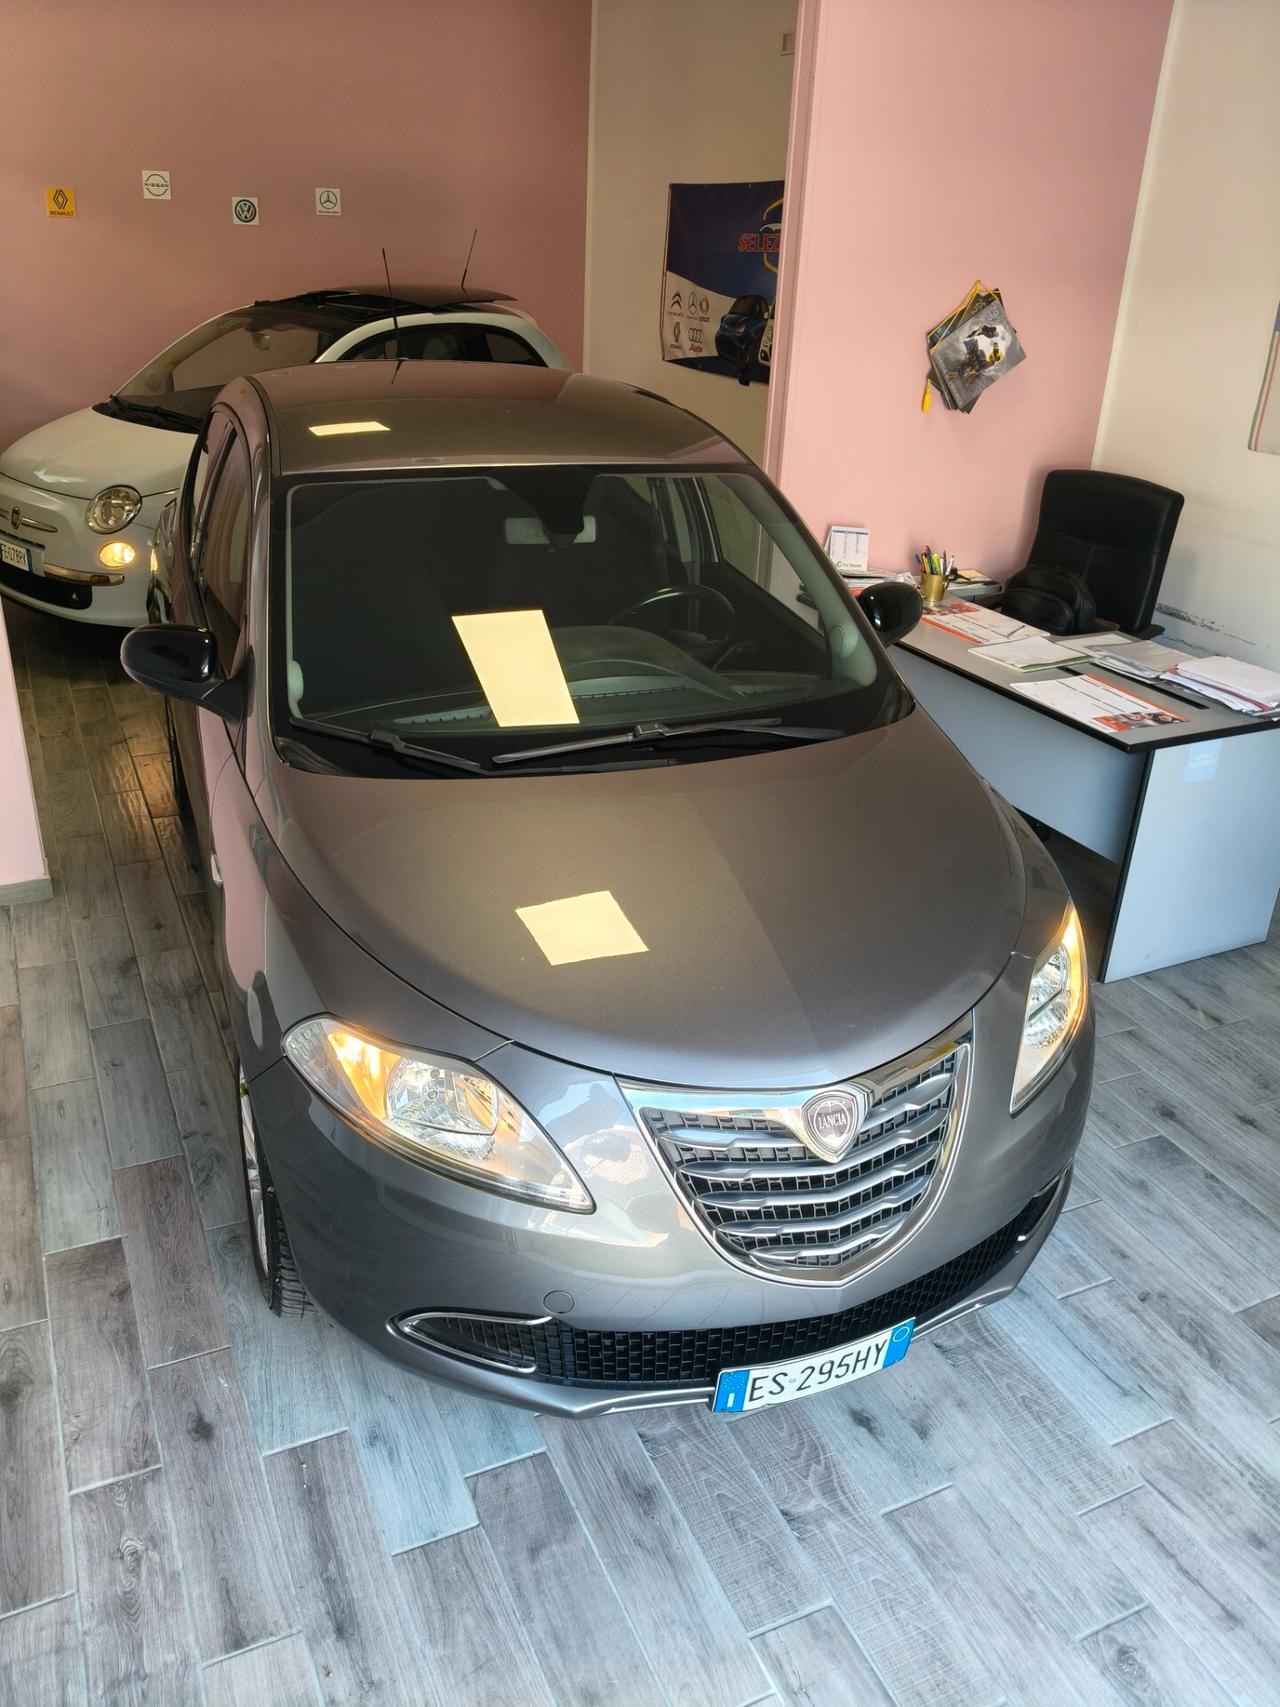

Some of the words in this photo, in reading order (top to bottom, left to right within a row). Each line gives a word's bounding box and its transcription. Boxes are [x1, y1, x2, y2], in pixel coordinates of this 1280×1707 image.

[818, 1112, 847, 1129] LANCIA
[748, 1372, 788, 1403] ES
[796, 1339, 888, 1392] 295HY
